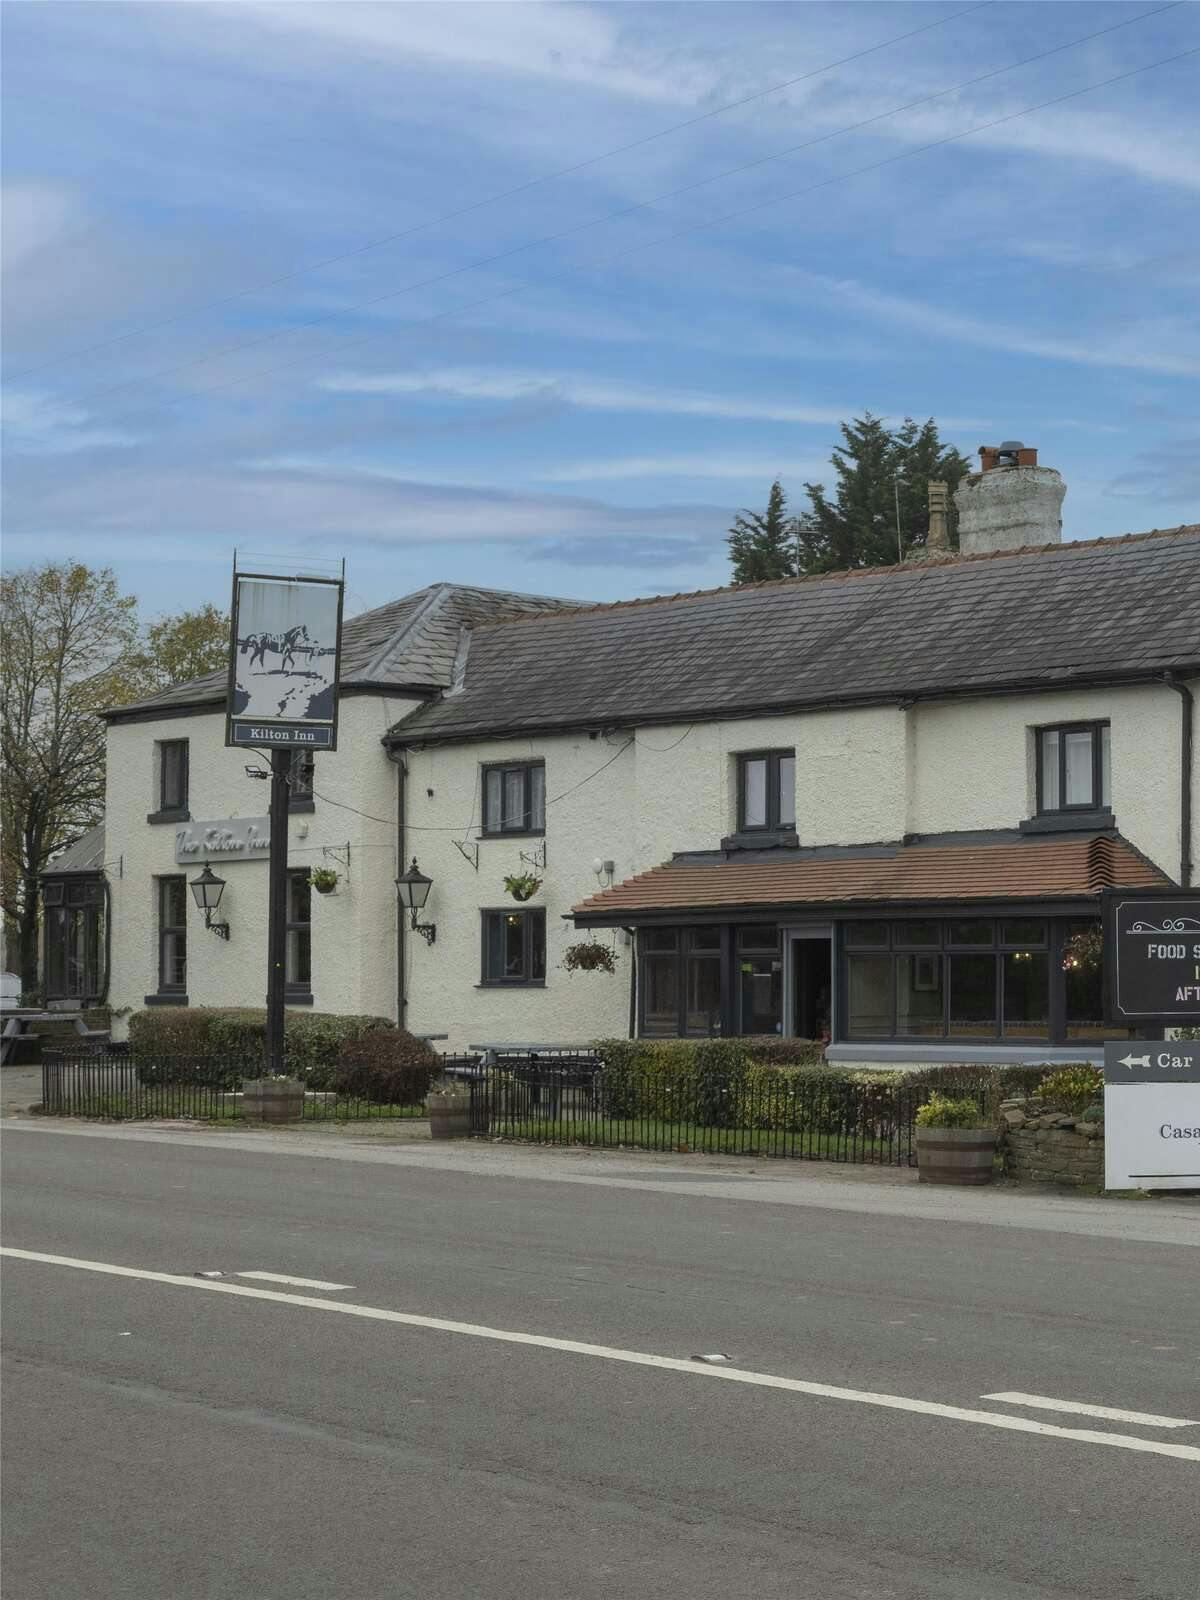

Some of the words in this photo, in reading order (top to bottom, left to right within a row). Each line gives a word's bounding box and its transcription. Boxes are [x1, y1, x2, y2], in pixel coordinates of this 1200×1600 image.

[250, 728, 289, 740] Kilton
[294, 730, 315, 741] Inn
[1147, 943, 1186, 960] FOOD
[1156, 1052, 1194, 1068] Car
